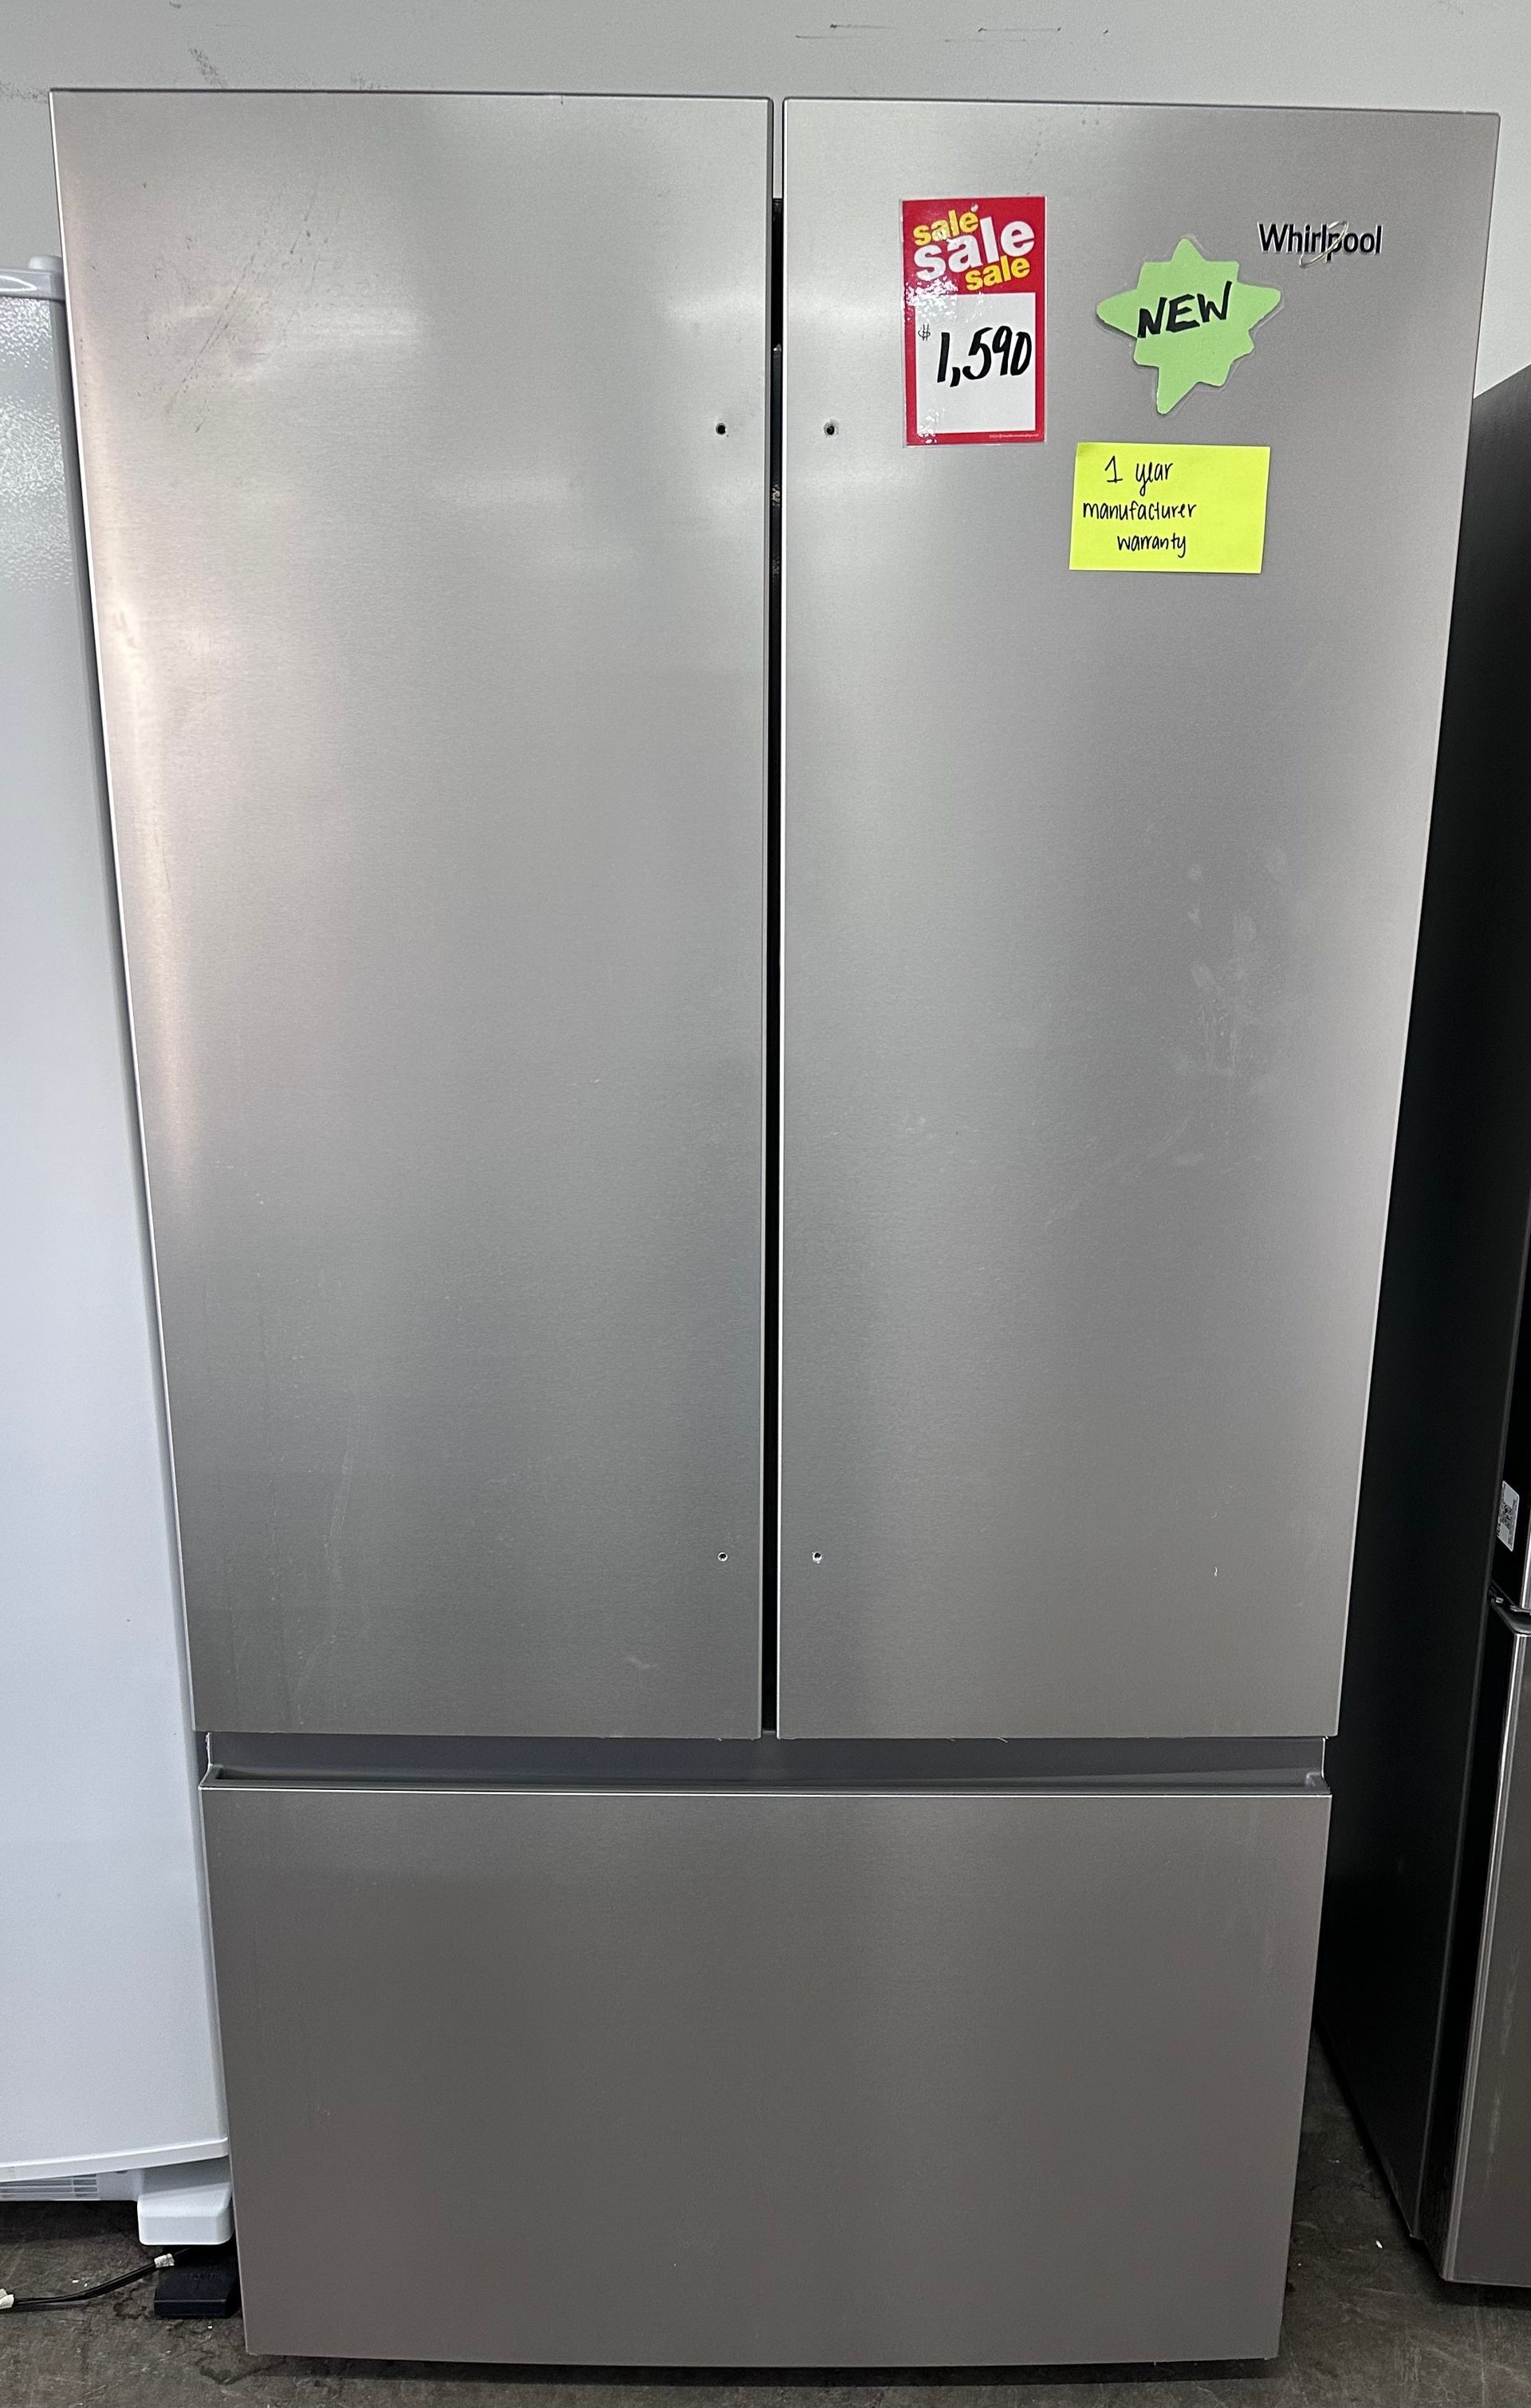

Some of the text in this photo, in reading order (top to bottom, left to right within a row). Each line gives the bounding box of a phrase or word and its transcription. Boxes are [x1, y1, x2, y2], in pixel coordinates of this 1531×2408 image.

[913, 210, 978, 246] sale
[1258, 222, 1383, 262] Whirlpool
[914, 217, 1034, 281] sale
[965, 255, 1030, 290] sale
[1137, 281, 1232, 338] NEW
[1104, 455, 1173, 496] 1 year
[1083, 501, 1196, 520] manufacturer
[1117, 533, 1186, 558] warranty
